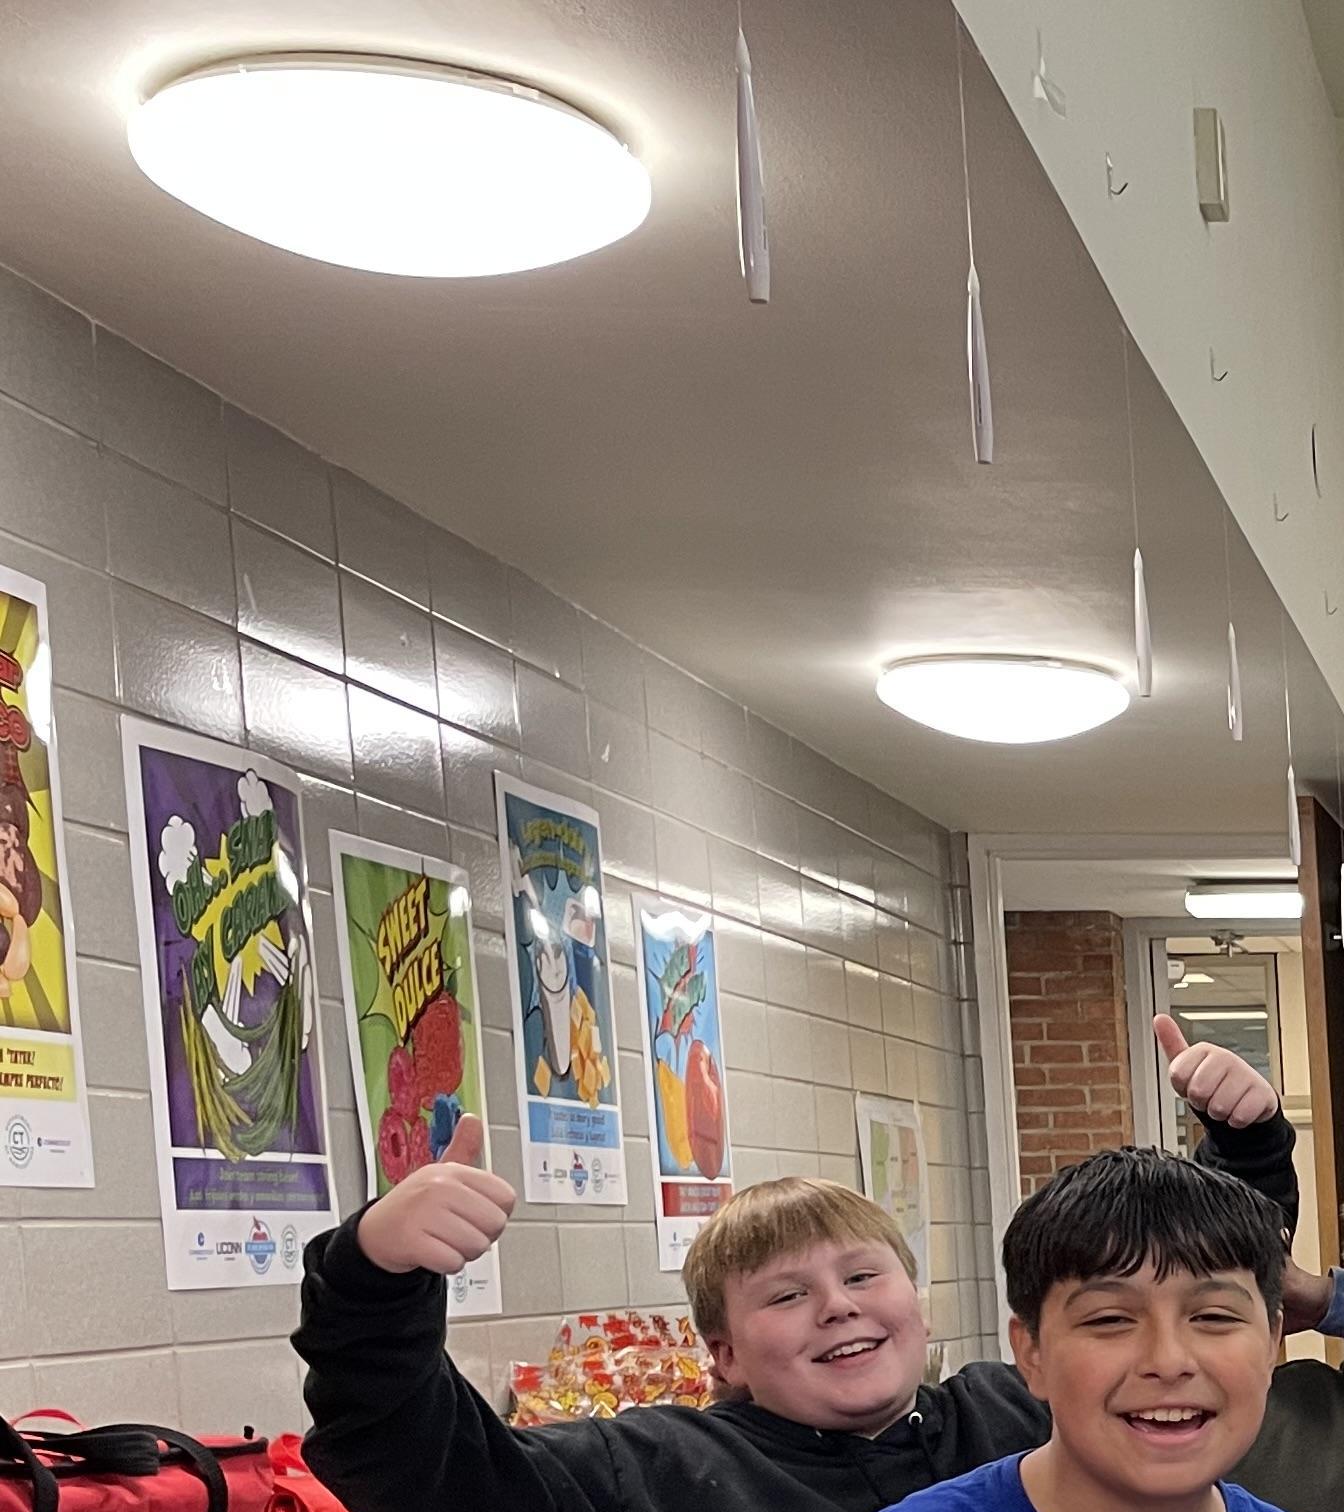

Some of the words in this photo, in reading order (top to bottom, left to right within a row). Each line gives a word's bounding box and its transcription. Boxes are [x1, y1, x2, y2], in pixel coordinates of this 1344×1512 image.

[377, 875, 430, 985] SWEET
[393, 939, 443, 1044] DULCE
[216, 1242, 242, 1255] UCONN
